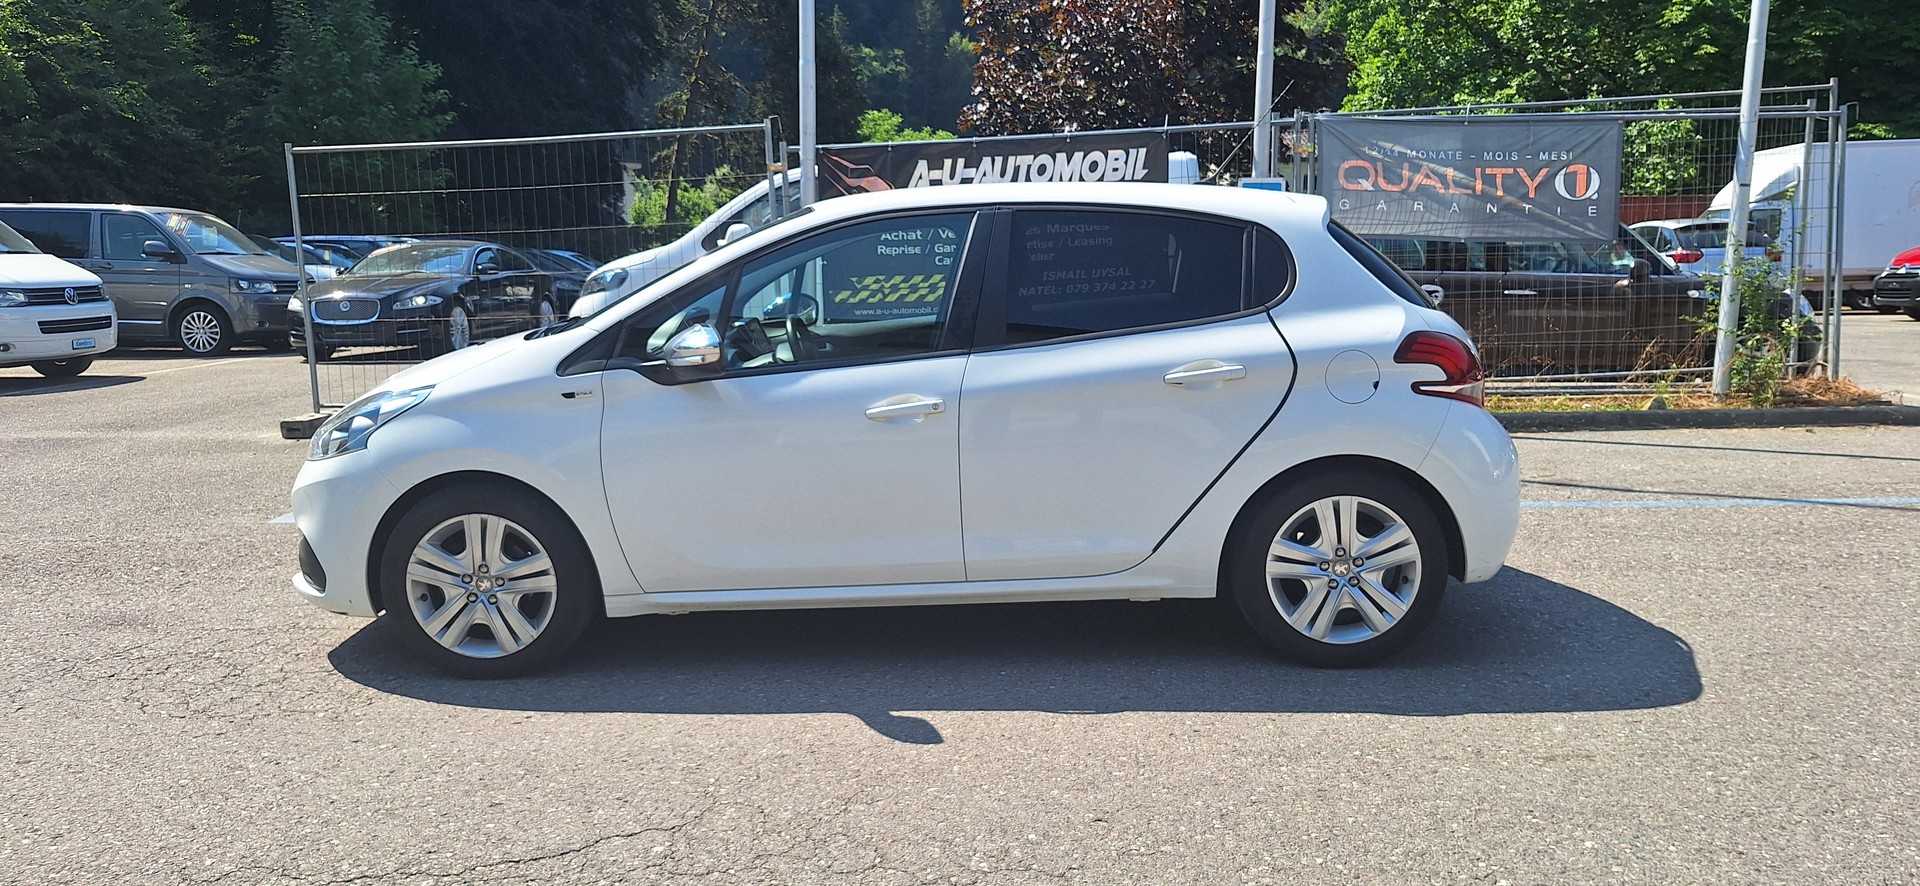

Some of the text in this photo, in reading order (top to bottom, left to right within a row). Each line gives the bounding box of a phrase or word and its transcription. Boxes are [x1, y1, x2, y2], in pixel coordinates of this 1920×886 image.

[1406, 149, 1463, 160] MONATE
[1483, 150, 1519, 161] MOIS
[1539, 150, 1574, 161] MESI
[907, 147, 1149, 188] A-U-AUTOMOBIL
[1338, 160, 1550, 199] QUALITY
[1338, 199, 1598, 217] GARANTIE
[880, 228, 923, 241] Achat
[1047, 223, 1110, 234] Marques
[877, 244, 922, 257] Reprise
[934, 243, 957, 253] Gar
[1068, 236, 1113, 247] Leasing
[1041, 266, 1131, 281] ISMAIL UYSAL
[1018, 279, 1156, 297] NATEL: 079 374 22 27
